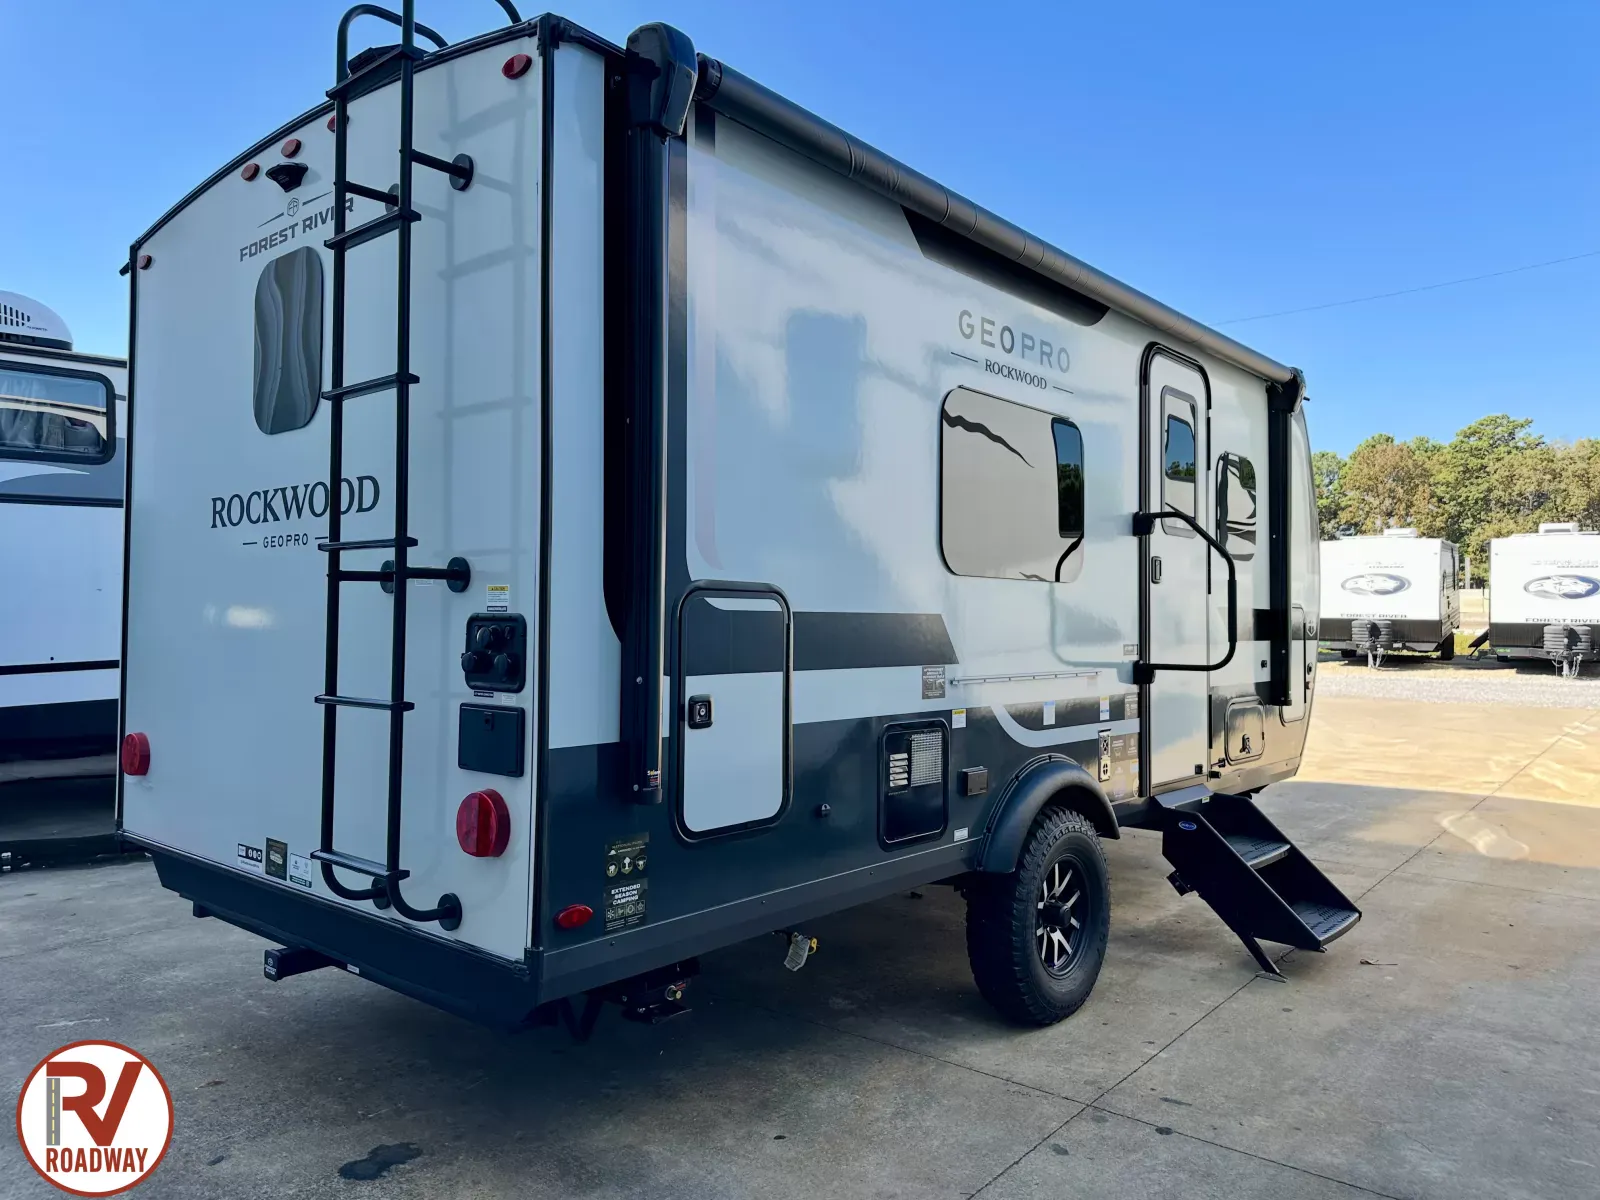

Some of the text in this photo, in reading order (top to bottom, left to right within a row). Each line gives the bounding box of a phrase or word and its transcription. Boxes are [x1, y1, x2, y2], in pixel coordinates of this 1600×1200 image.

[240, 222, 299, 263] FOREST
[959, 309, 1070, 374] GEOPRO
[985, 358, 1047, 390] ROCKWOOD
[210, 475, 380, 529] ROCKWOOD
[263, 533, 309, 549] GEOPRO
[611, 883, 641, 895] EXTENDED
[612, 894, 639, 906] CAMPING
[614, 889, 638, 900] SEASON
